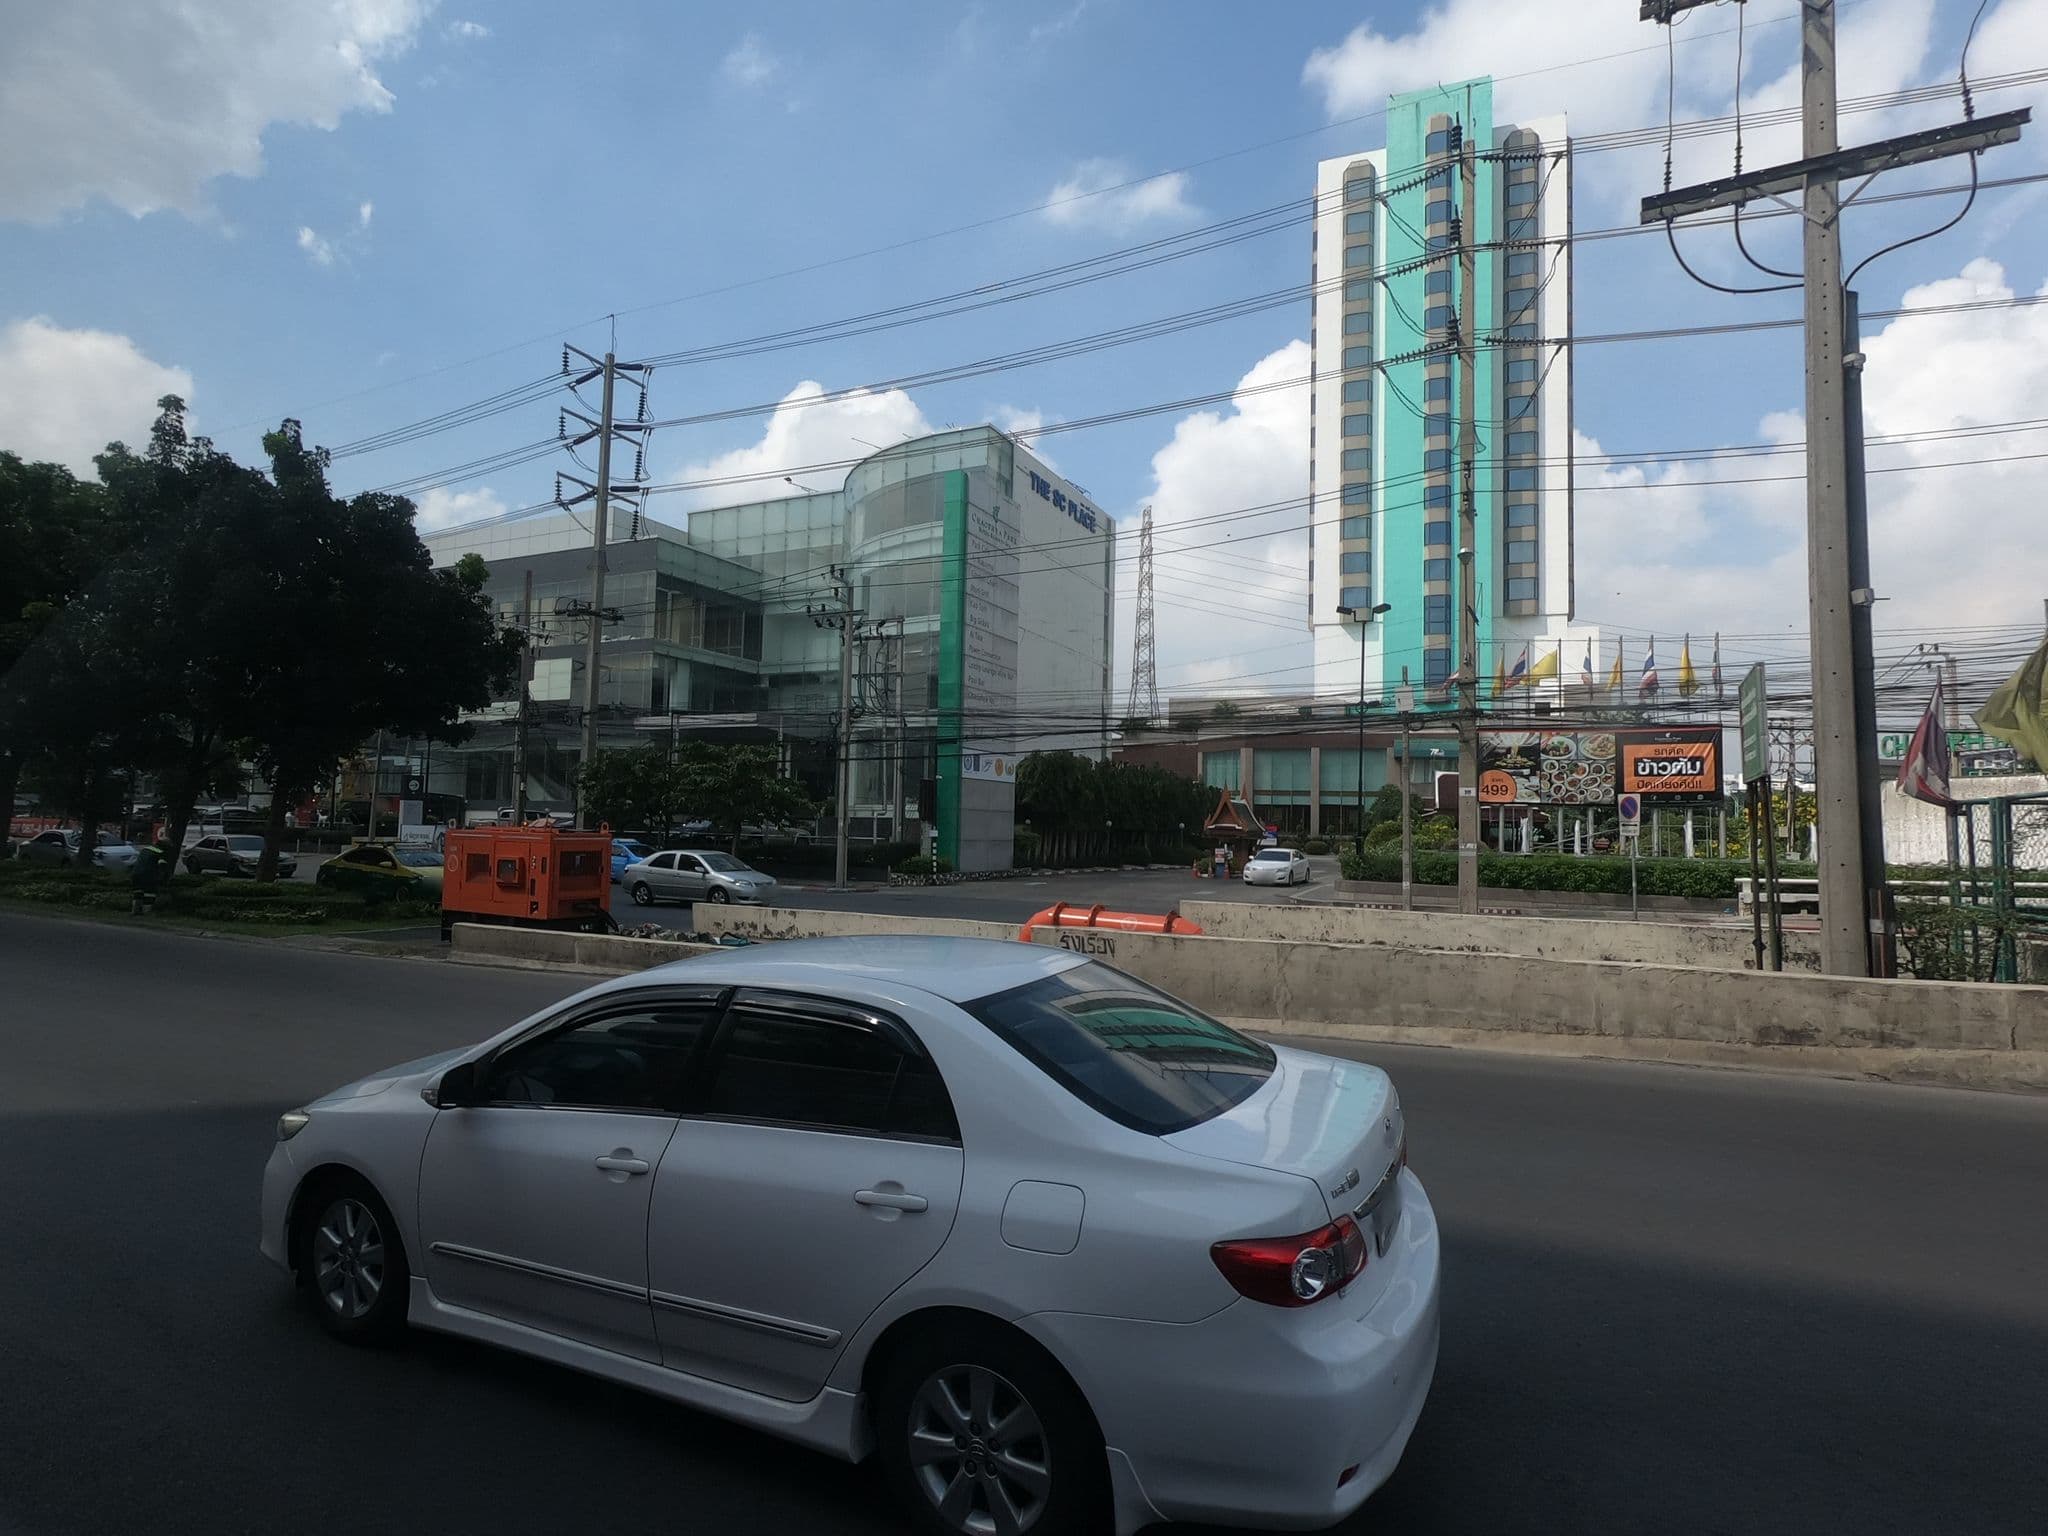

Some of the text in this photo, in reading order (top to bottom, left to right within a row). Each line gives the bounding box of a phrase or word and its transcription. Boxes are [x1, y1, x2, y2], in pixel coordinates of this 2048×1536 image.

[1029, 470, 1051, 501] THE
[1068, 499, 1097, 534] PLACE
[1637, 757, 1701, 776] ข้าวต้ม
